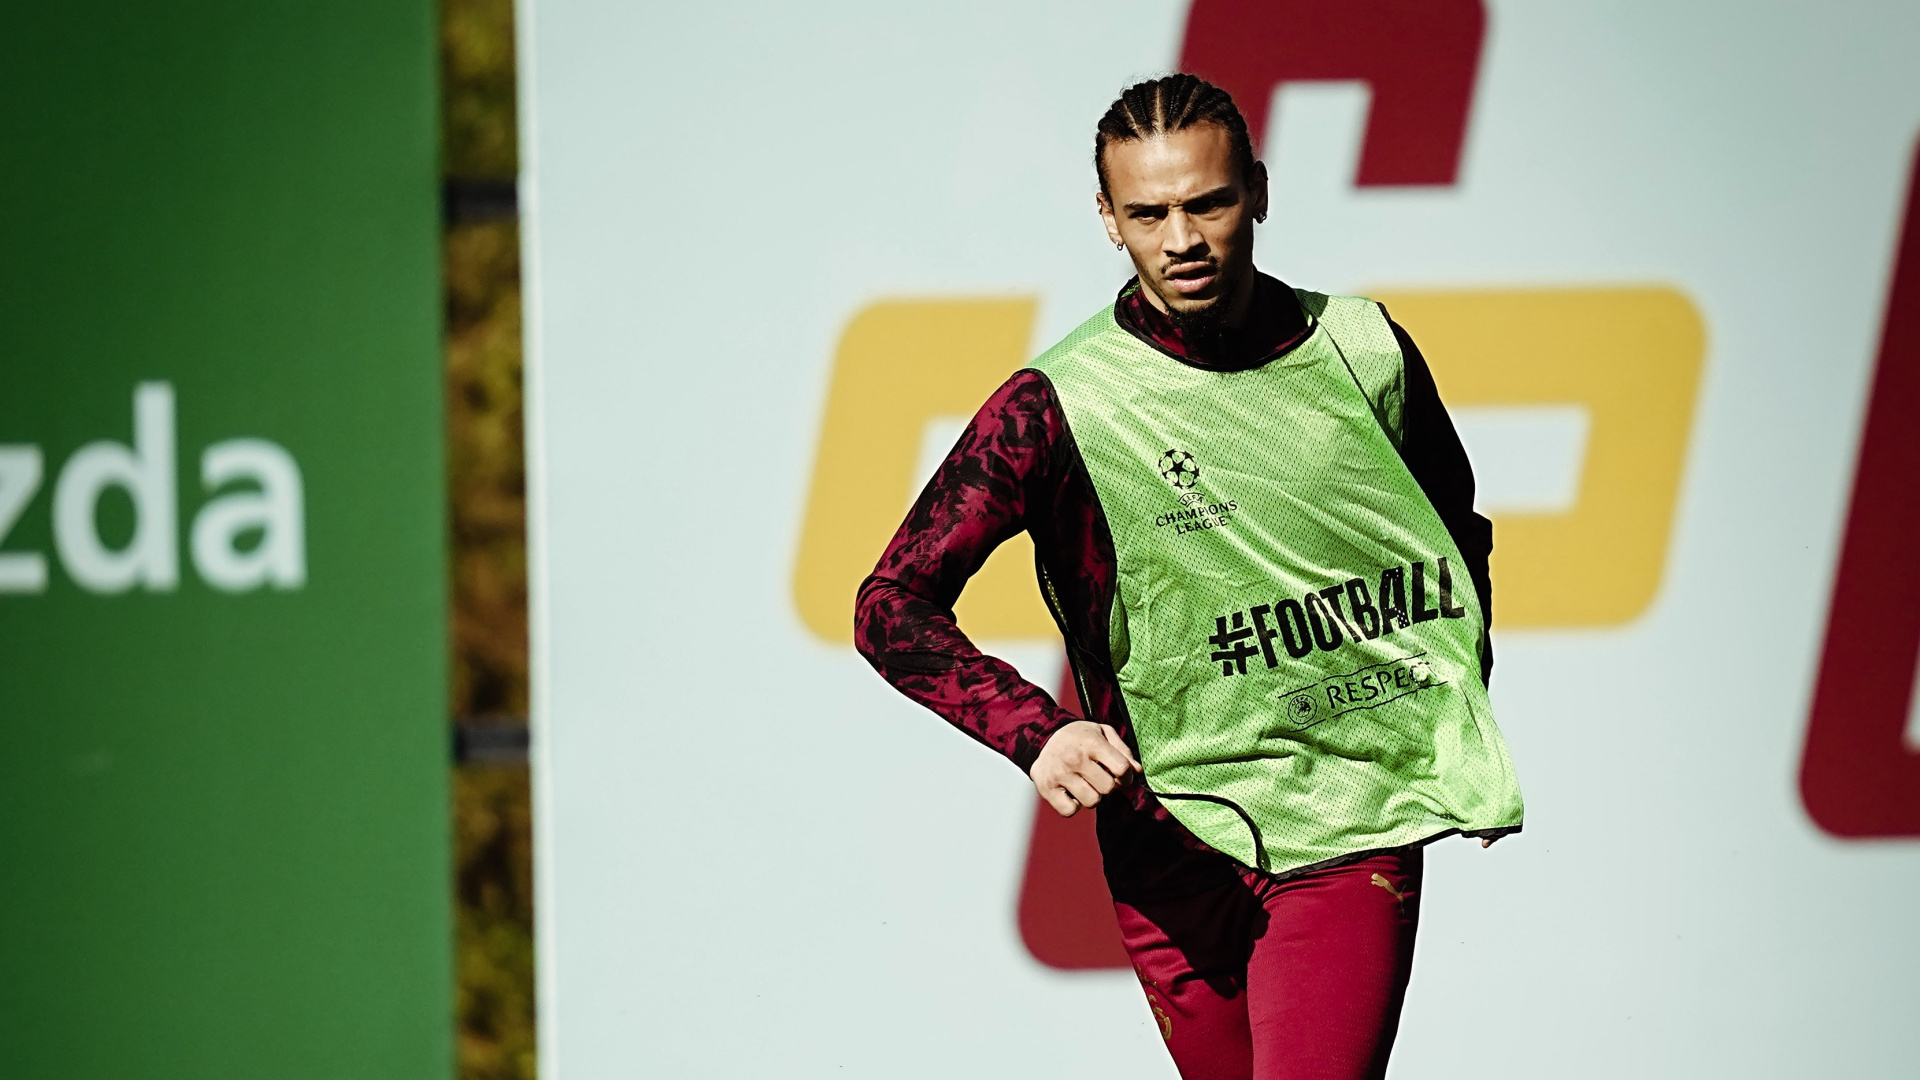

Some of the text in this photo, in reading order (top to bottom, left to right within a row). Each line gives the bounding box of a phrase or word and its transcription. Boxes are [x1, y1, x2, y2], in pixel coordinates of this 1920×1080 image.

[1180, 494, 1204, 506] UEFA
[1156, 500, 1238, 527] CHAMPIONS
[1176, 515, 1228, 535] LEAGUE
[1209, 556, 1465, 677] #FOOTBALL
